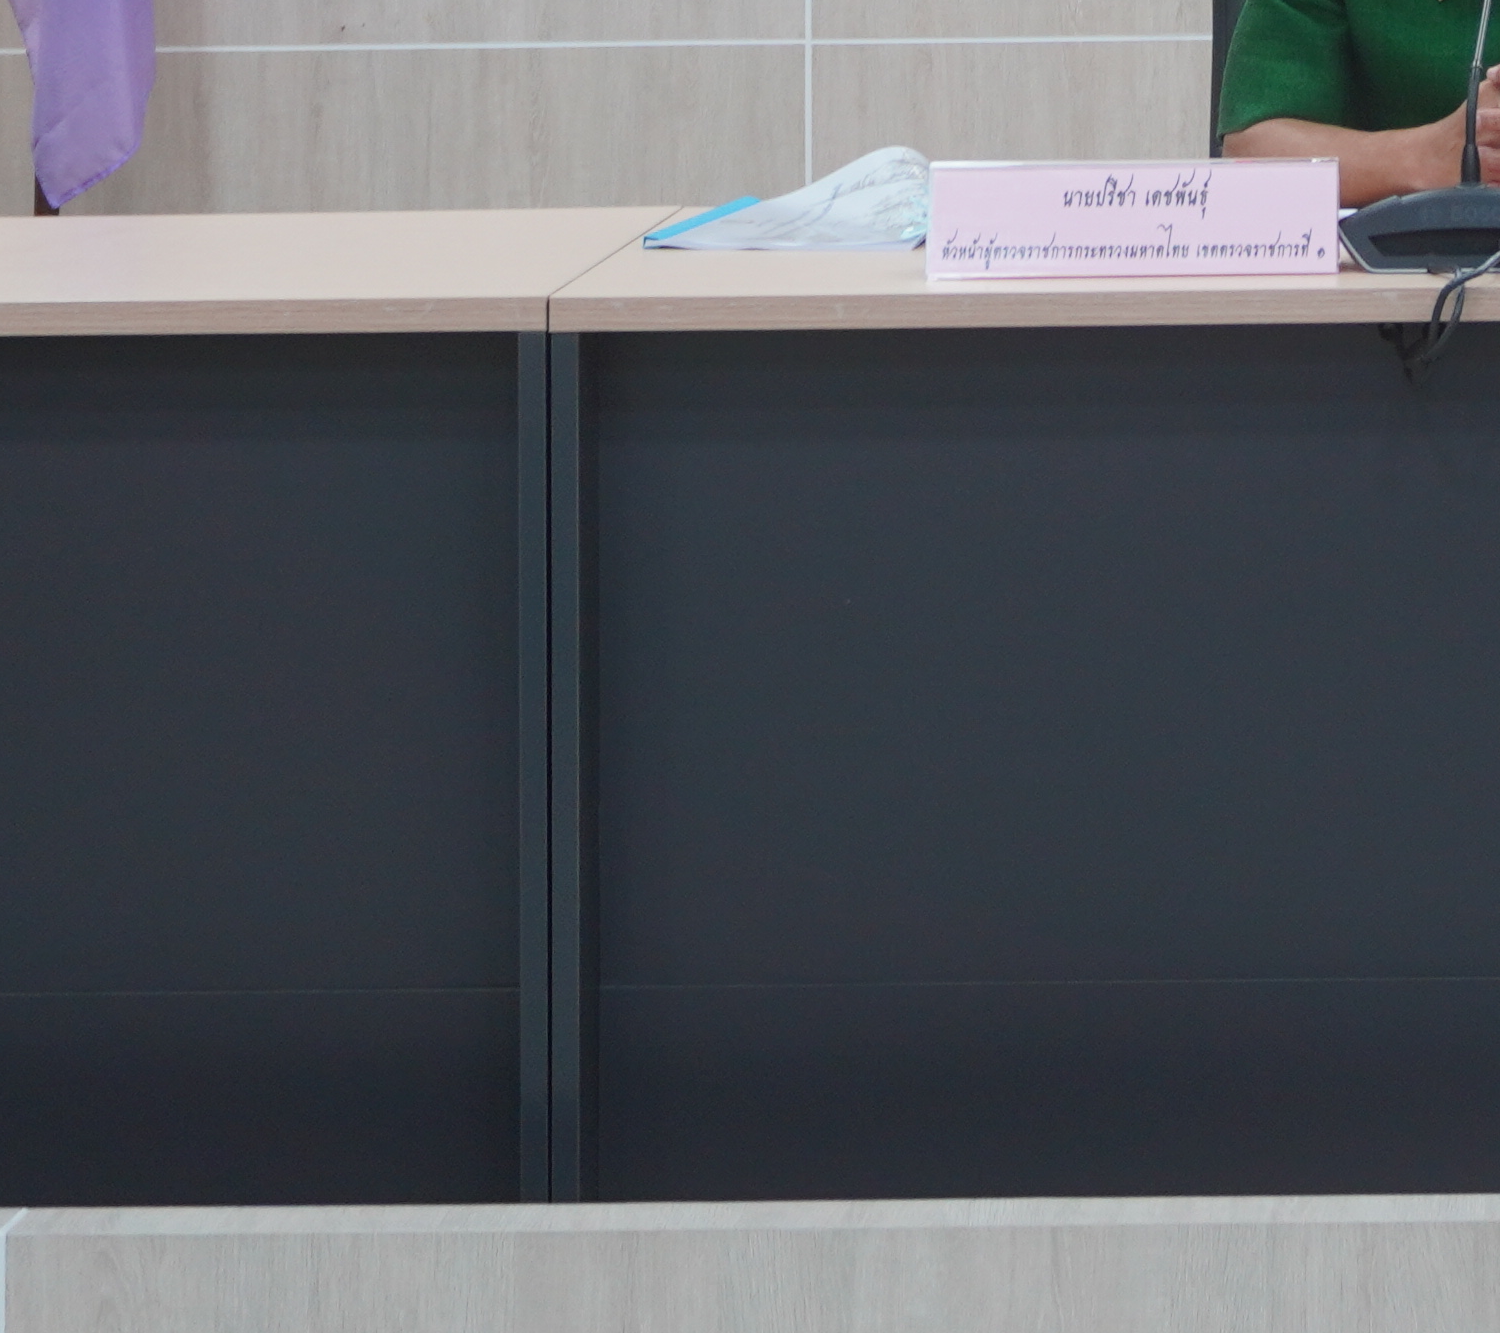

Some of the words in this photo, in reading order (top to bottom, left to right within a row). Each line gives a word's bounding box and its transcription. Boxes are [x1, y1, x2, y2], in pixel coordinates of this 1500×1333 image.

[1063, 173, 1136, 208] นายปรีชา
[1145, 168, 1212, 219] เดชพันธุ์
